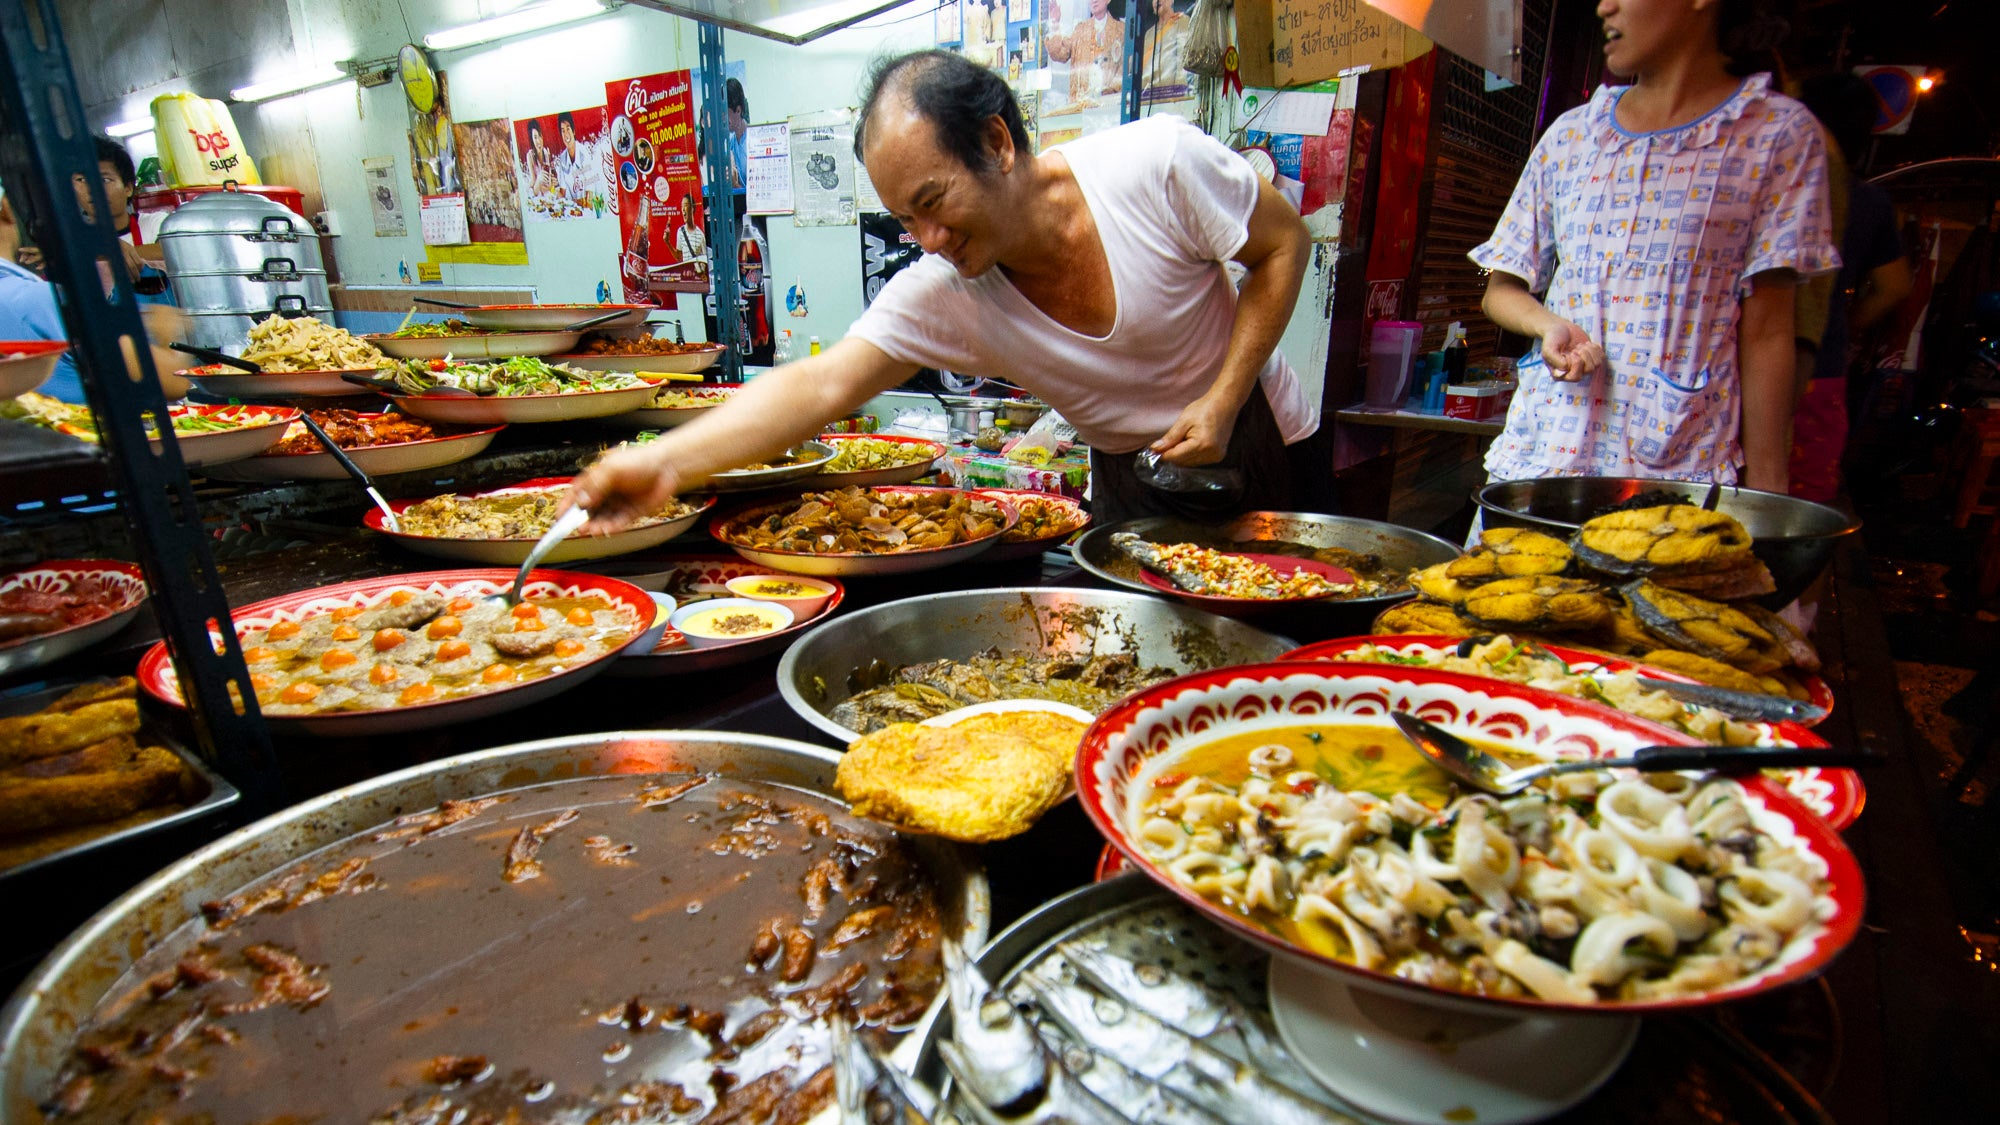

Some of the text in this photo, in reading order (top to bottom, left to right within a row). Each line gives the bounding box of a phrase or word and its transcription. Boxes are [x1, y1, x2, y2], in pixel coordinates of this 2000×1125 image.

[650, 122, 687, 145] 10,000,000
[209, 154, 239, 173] super
[602, 151, 620, 216] Coca-Cola
